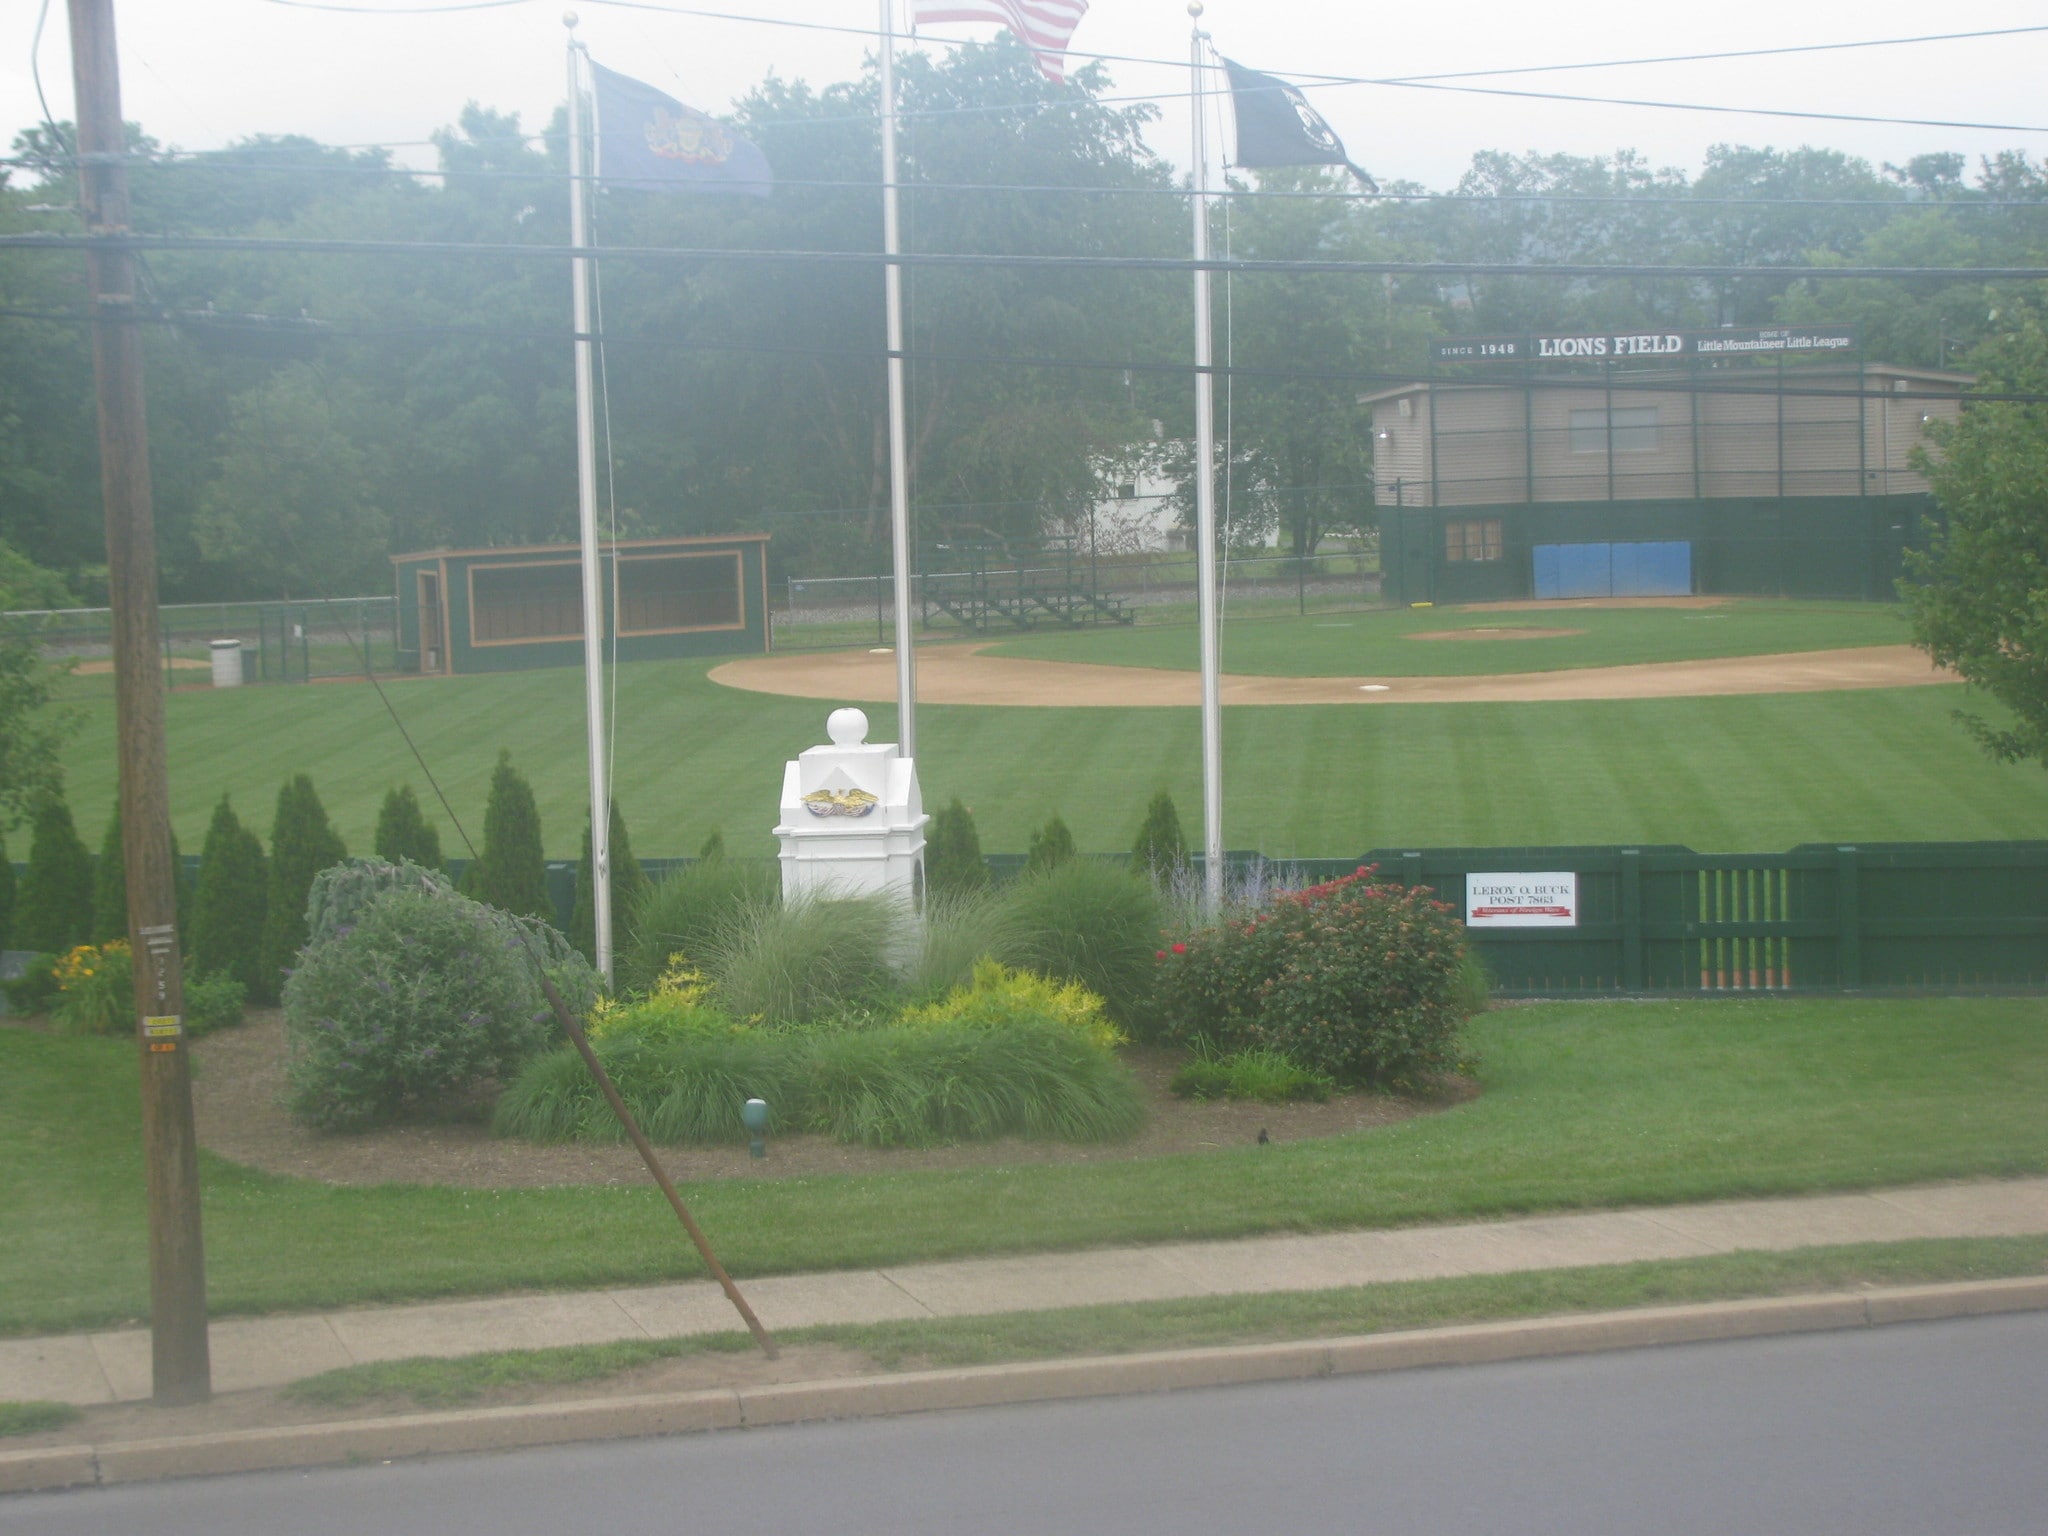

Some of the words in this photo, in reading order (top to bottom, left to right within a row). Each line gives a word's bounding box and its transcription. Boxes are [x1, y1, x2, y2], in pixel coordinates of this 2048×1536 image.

[1539, 337, 1607, 357] LIONS
[1613, 335, 1682, 355] FIELD
[1697, 340, 1722, 351] Little
[1723, 338, 1785, 351] Mountaineer
[1786, 336, 1810, 348] Little
[1812, 336, 1848, 348] League
[1441, 346, 1473, 355] SINCE
[1480, 344, 1515, 355] 1948
[1473, 886, 1516, 895] LEROY
[1534, 885, 1569, 894] BUCK
[1489, 896, 1524, 905] POST
[1527, 895, 1554, 904] 7863
